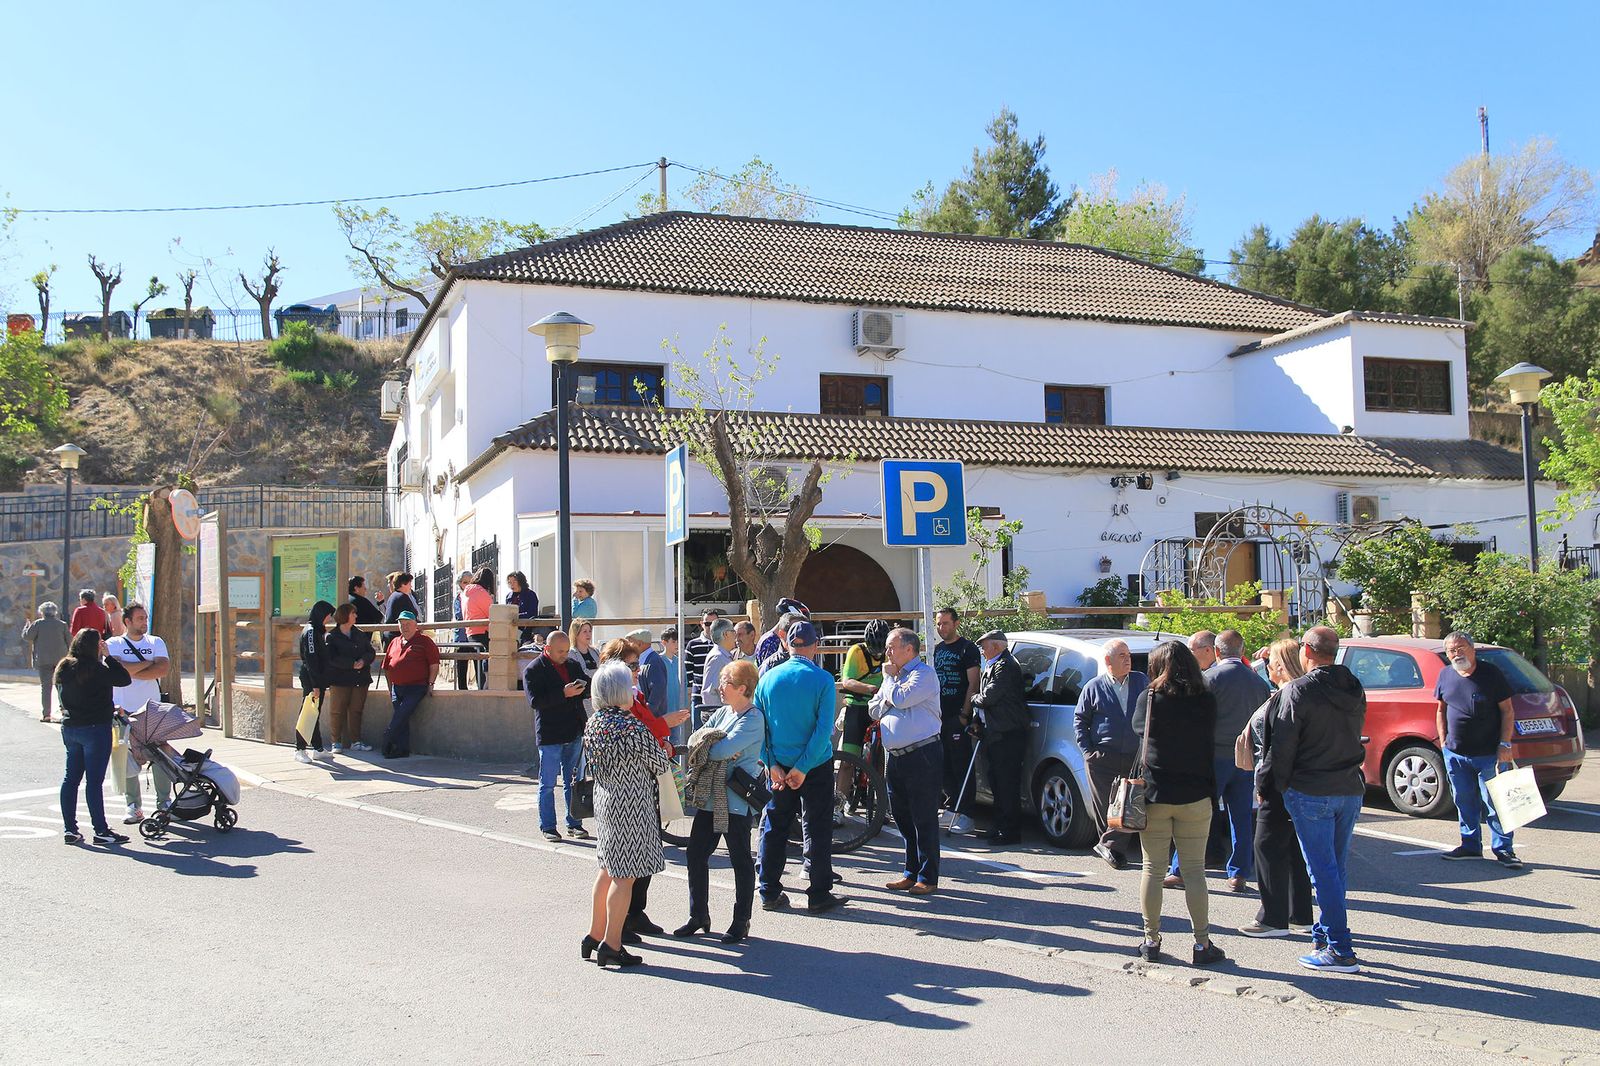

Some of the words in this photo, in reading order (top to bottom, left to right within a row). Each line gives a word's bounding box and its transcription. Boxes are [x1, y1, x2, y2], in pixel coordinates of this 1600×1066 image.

[669, 461, 682, 533] P
[899, 470, 948, 536] P
[1111, 503, 1129, 517] LAS
[123, 647, 152, 655] aas
